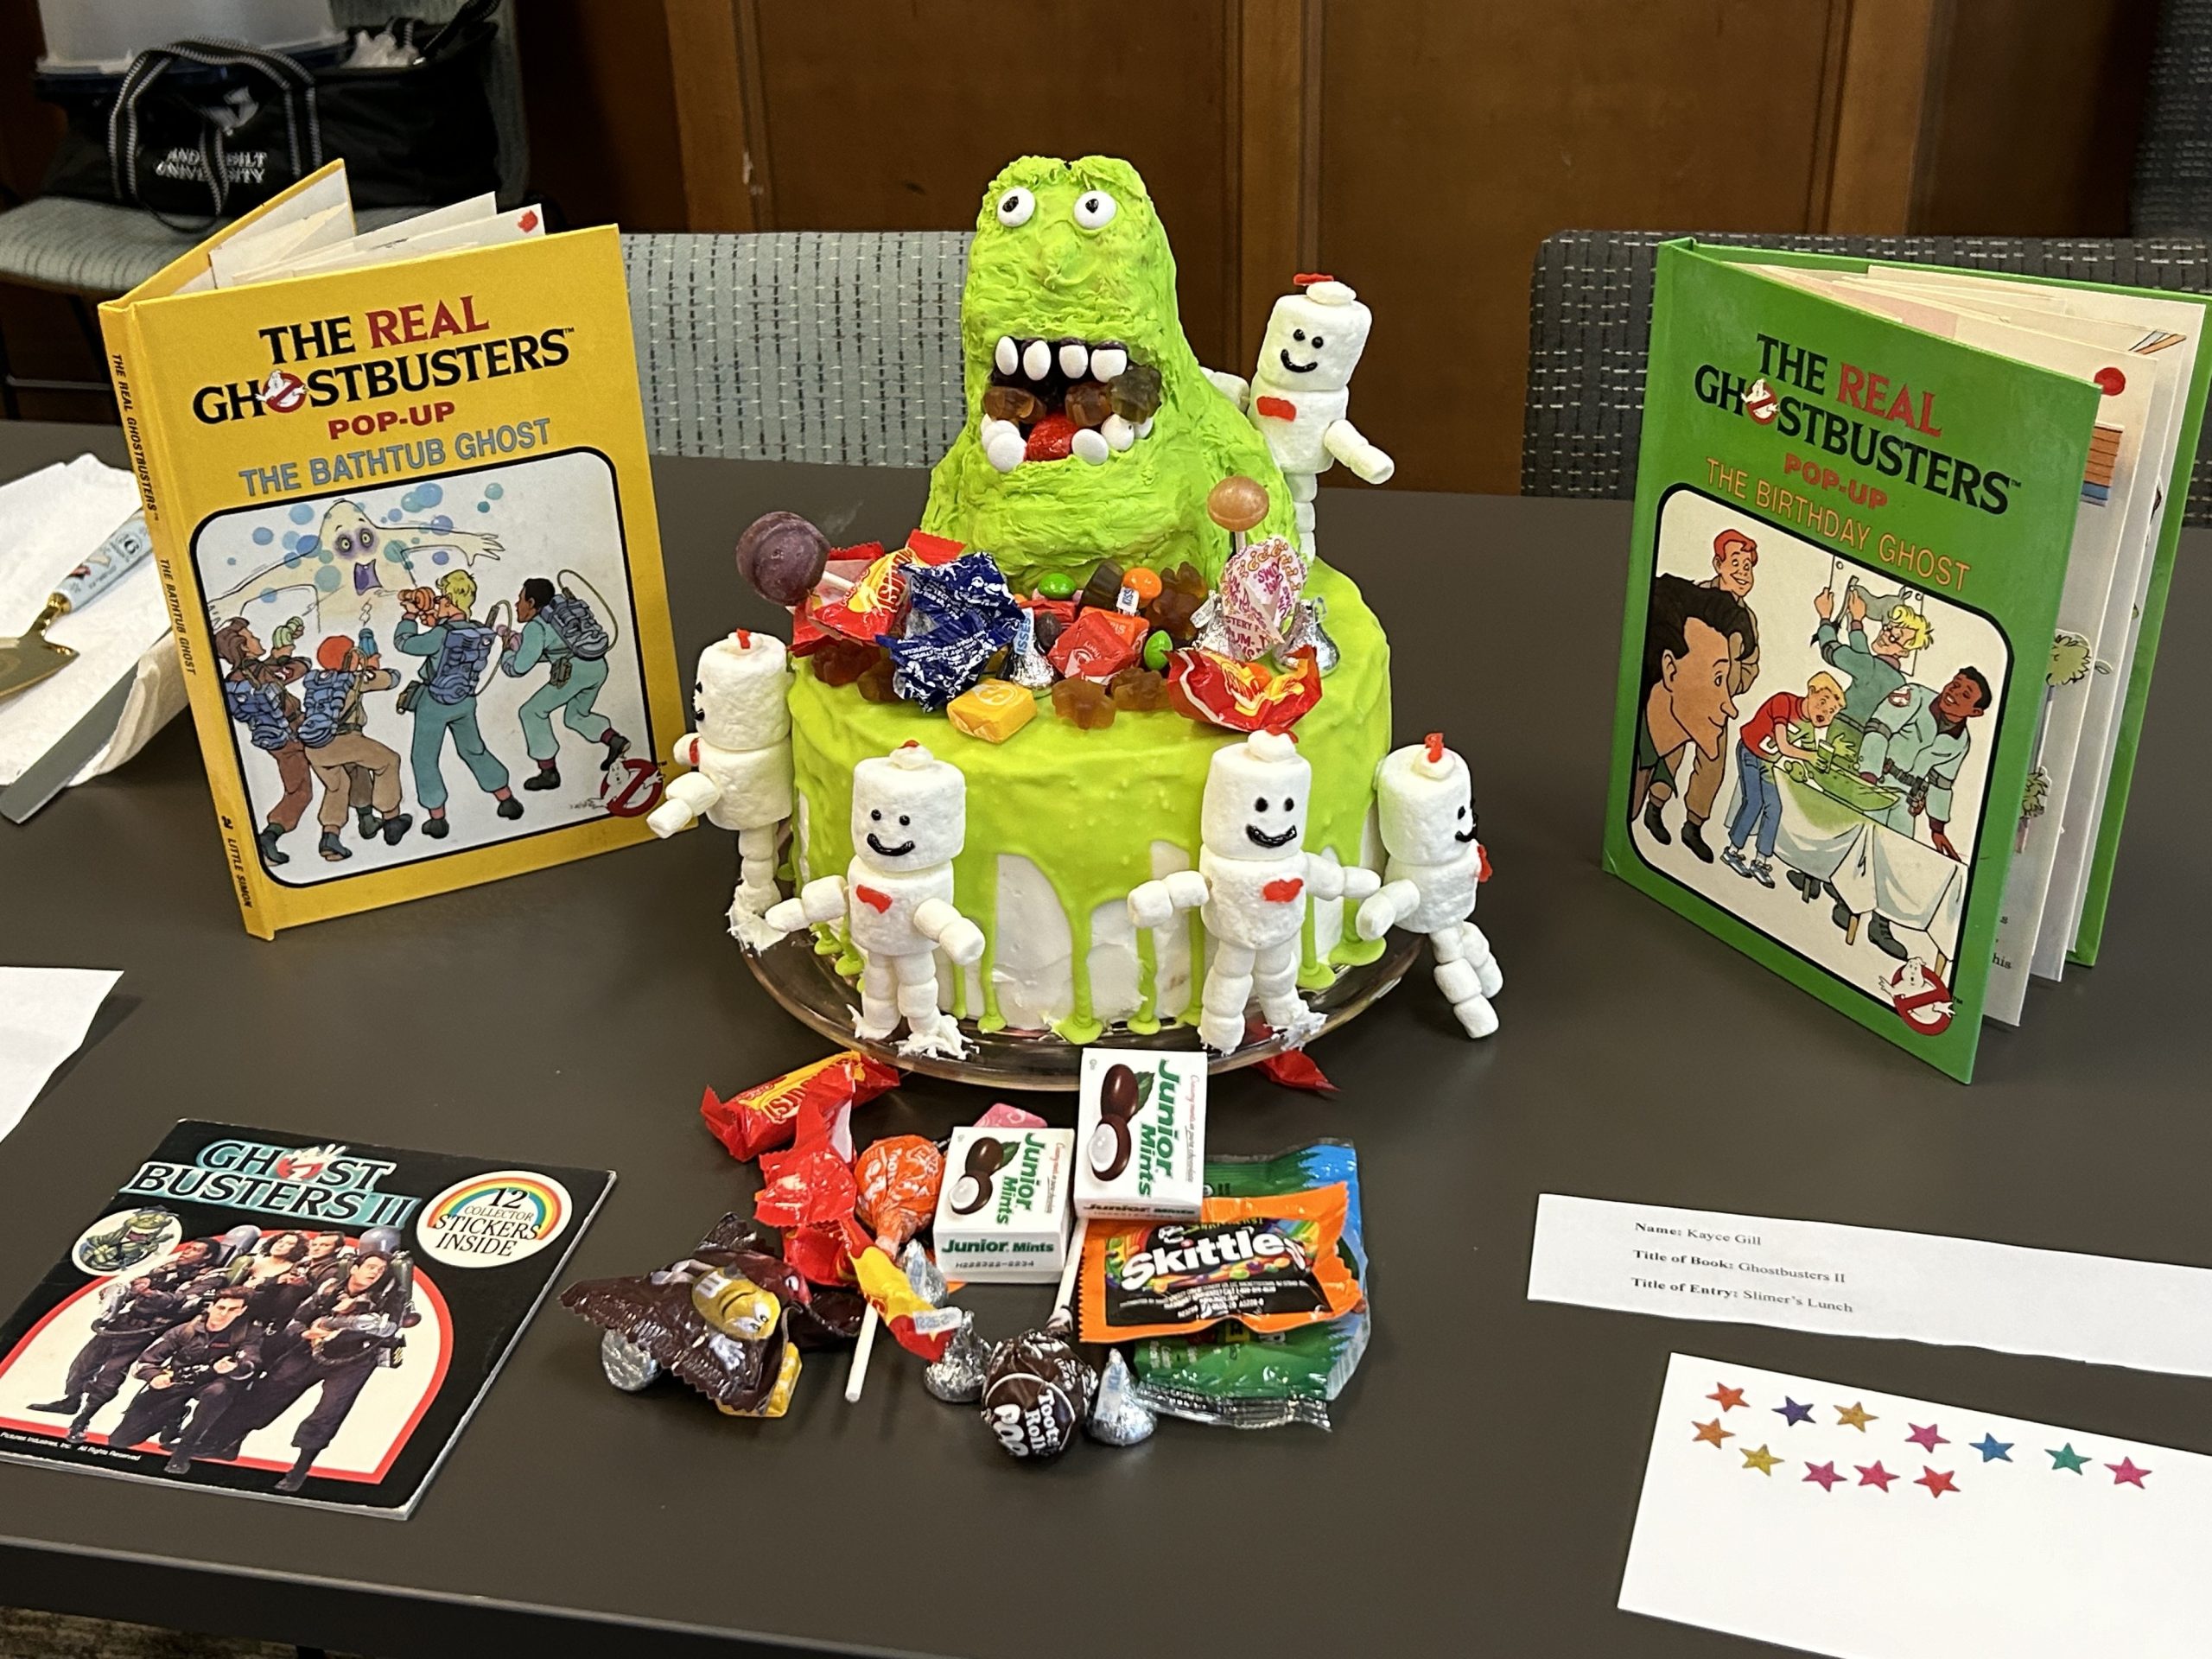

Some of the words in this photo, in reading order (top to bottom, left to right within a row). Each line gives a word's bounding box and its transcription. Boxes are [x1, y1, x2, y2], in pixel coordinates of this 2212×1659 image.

[259, 316, 356, 365] THE
[365, 295, 490, 349] REAL
[111, 353, 126, 378] THE
[193, 328, 570, 424] GHOSTBUSTERS
[1756, 334, 1828, 396] THE
[1836, 364, 1942, 438] REAL
[115, 382, 133, 411] REAL
[327, 400, 455, 440] POP-UP
[127, 417, 157, 512] GHOSTBUSTERS
[239, 462, 302, 497] THE
[310, 435, 447, 486] BATHTUB
[454, 418, 553, 461] GHOST
[1694, 364, 2011, 516] GHOSTBUSTERS
[1783, 452, 1889, 512] POP-UP
[1706, 457, 1749, 502] THE
[1756, 480, 1872, 551] BIRTHDAY
[1878, 533, 1971, 592] GHOST
[160, 559, 172, 582] THE
[167, 584, 187, 632] BATHTUB
[182, 632, 196, 675] GHOST
[1016, 617, 1032, 654] ISSES
[227, 837, 243, 871] LITTLE
[237, 873, 252, 908] SIMON
[1157, 1058, 1181, 1179] Junior
[202, 1142, 392, 1191] GHOST
[1017, 1132, 1046, 1211] Junior
[1138, 1122, 1157, 1198] Mints
[130, 1165, 366, 1223] BUSTERS
[368, 1196, 416, 1226] II
[464, 1205, 534, 1221] COLLECTOR
[488, 1187, 529, 1209] 12
[997, 1175, 1018, 1225] Mints
[434, 1214, 541, 1240] STICKERS
[435, 1233, 517, 1256] INSIDE
[942, 1239, 1008, 1252] Junior
[1013, 1242, 1054, 1252] Mints
[1635, 1222, 1682, 1236] Name:
[1735, 1234, 1762, 1246] Gill
[1633, 1249, 1667, 1262] Title
[1671, 1255, 1688, 1264] of
[1691, 1255, 1734, 1269] Book:
[1738, 1262, 1830, 1281] Ghostbusters
[1834, 1273, 1846, 1283] II
[1631, 1277, 1666, 1290] Title
[1669, 1283, 1686, 1292] of
[1690, 1284, 1738, 1299] Entry:
[1743, 1289, 1803, 1306] Slimer's
[1808, 1298, 1853, 1313] Lunch
